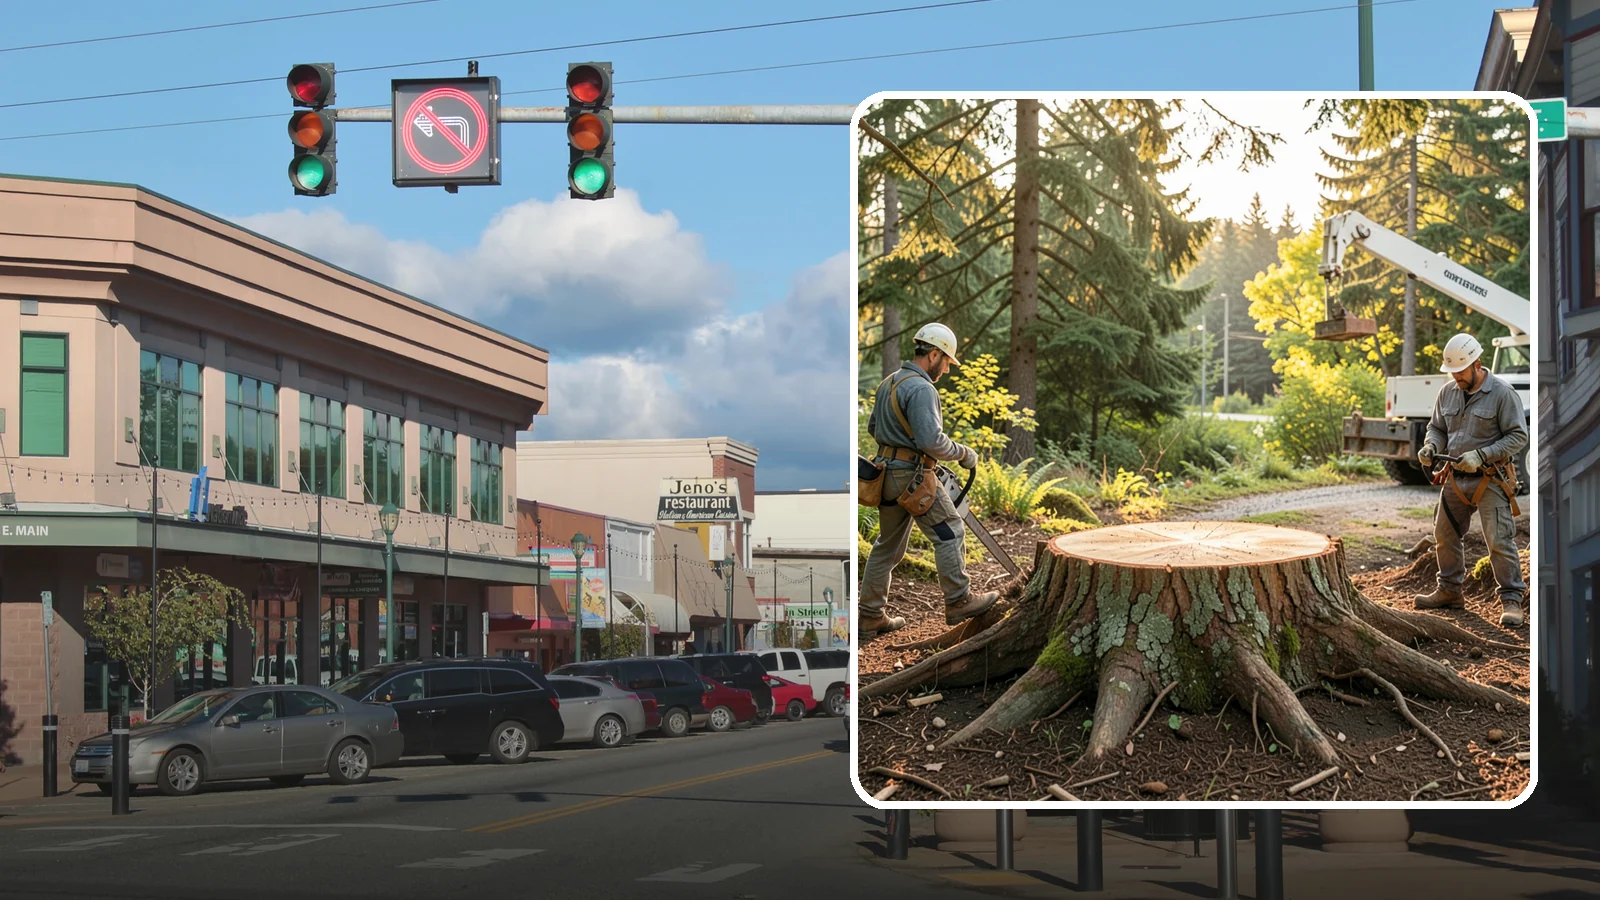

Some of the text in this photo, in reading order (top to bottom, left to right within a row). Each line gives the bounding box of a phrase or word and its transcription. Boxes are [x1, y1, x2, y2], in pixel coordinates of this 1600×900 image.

[669, 480, 728, 494] Jeno's
[665, 496, 731, 509] restaurant
[658, 510, 682, 519] Italian
[686, 510, 715, 519] American
[715, 510, 738, 519] Cuisine
[2, 525, 49, 536] E. MAIN
[797, 608, 828, 616] Street
[790, 618, 823, 626] lass
